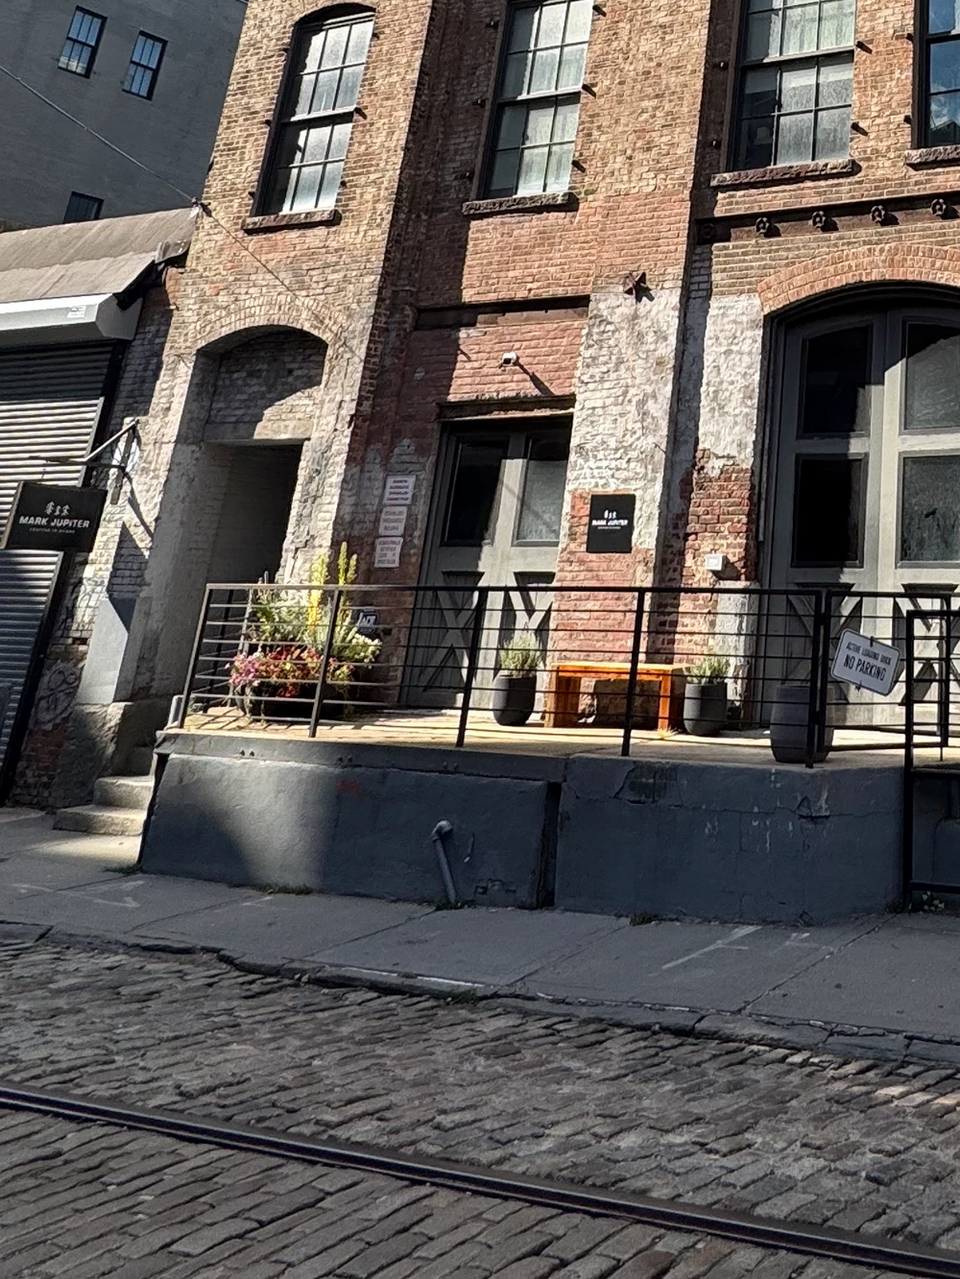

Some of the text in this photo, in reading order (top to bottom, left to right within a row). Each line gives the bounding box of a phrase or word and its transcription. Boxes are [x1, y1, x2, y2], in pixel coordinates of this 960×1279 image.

[19, 515, 90, 528] MARK JUPITER
[844, 654, 887, 681] NO PARKING
